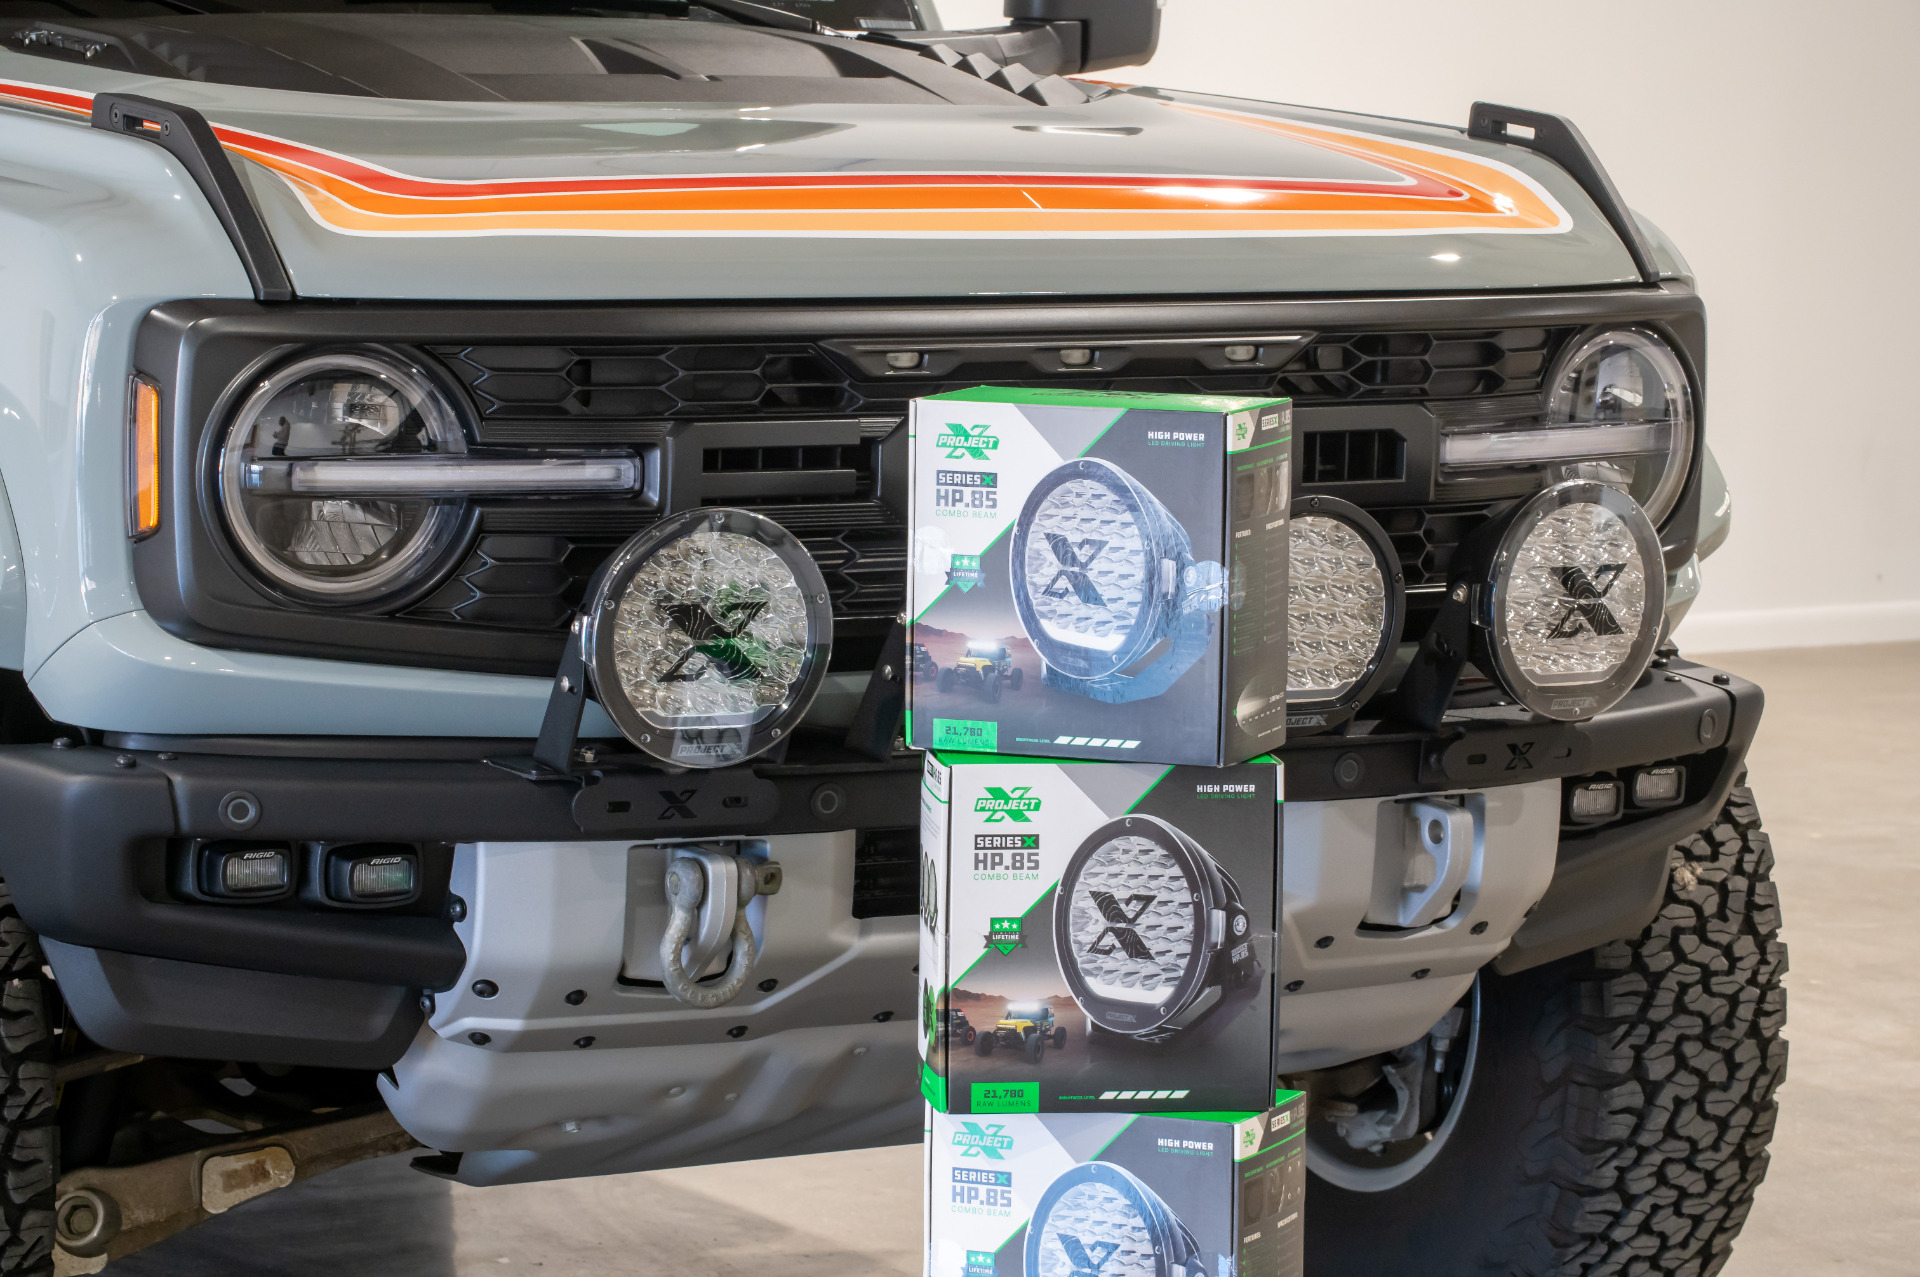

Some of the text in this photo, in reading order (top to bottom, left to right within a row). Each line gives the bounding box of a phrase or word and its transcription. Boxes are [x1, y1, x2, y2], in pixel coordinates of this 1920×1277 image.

[1147, 431, 1205, 441] HIGH POWER
[938, 436, 995, 448] PROJECT
[936, 488, 997, 509] HP.85
[935, 509, 997, 519] COMBO BEAM
[1286, 716, 1314, 727] OJECT
[945, 725, 983, 737] 21,780
[1651, 767, 1676, 775] RIGID
[1196, 784, 1256, 793] HIGH POWER
[976, 799, 1040, 810] PROJECT
[243, 851, 276, 860] RIGID
[370, 856, 402, 866] RIGID
[973, 852, 1040, 871] HP.85
[973, 873, 1039, 881] COMBO BEAM
[983, 1089, 1025, 1100] 21,780
[953, 1133, 1012, 1148] PROJECT
[1157, 1138, 1214, 1151] HIGH POWER
[951, 1184, 1012, 1208] HP.85
[951, 1205, 1012, 1217] COMBO BEAM
[968, 1266, 993, 1275] LIFETIME
